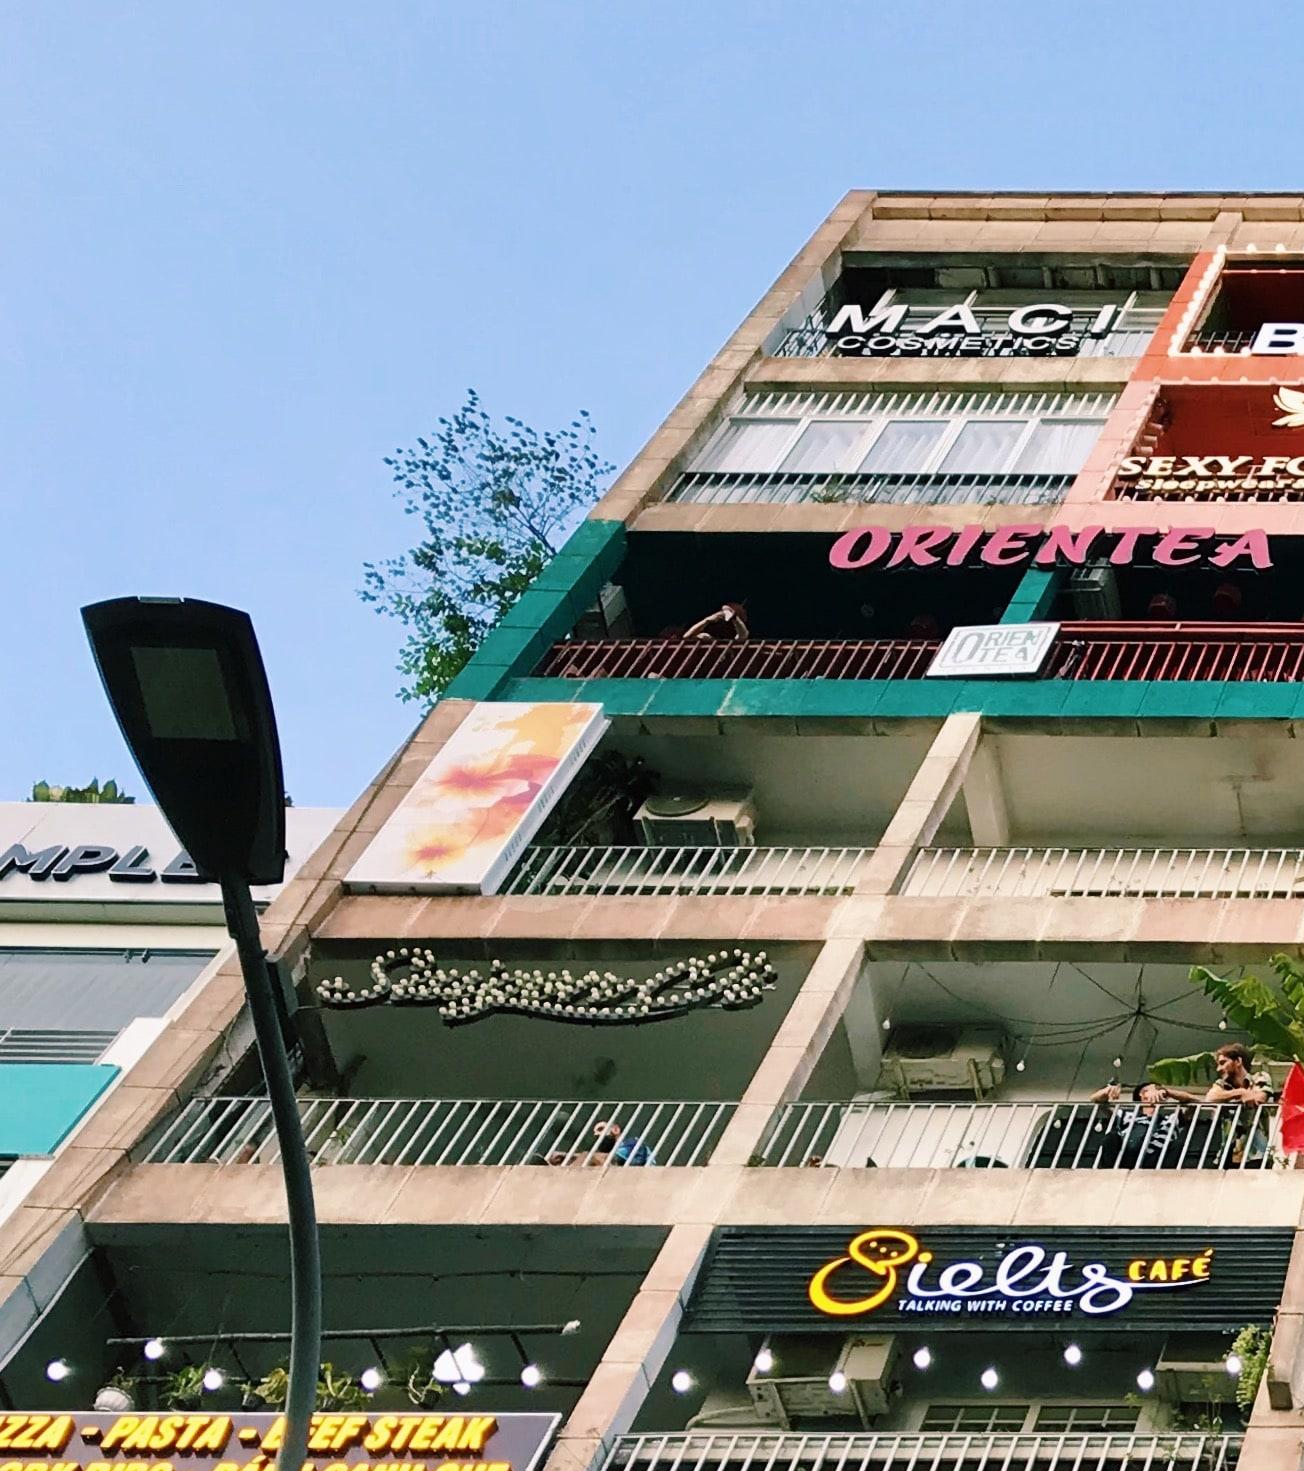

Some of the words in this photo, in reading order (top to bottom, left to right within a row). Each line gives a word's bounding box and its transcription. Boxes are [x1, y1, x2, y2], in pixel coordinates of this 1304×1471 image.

[826, 303, 1118, 337] MACI
[836, 334, 1080, 351] COSMETICS
[1117, 456, 1254, 477] SEXY
[828, 524, 1275, 570] ORIENTEA
[1128, 1248, 1215, 1282] CAFÉ
[898, 1299, 964, 1312] TALKING
[966, 1299, 1010, 1312] WITH
[1011, 1299, 1074, 1312] COFFEE
[0, 1416, 73, 1449] ZZA
[101, 1416, 232, 1450] PASTA
[363, 1416, 497, 1450] STEAK
